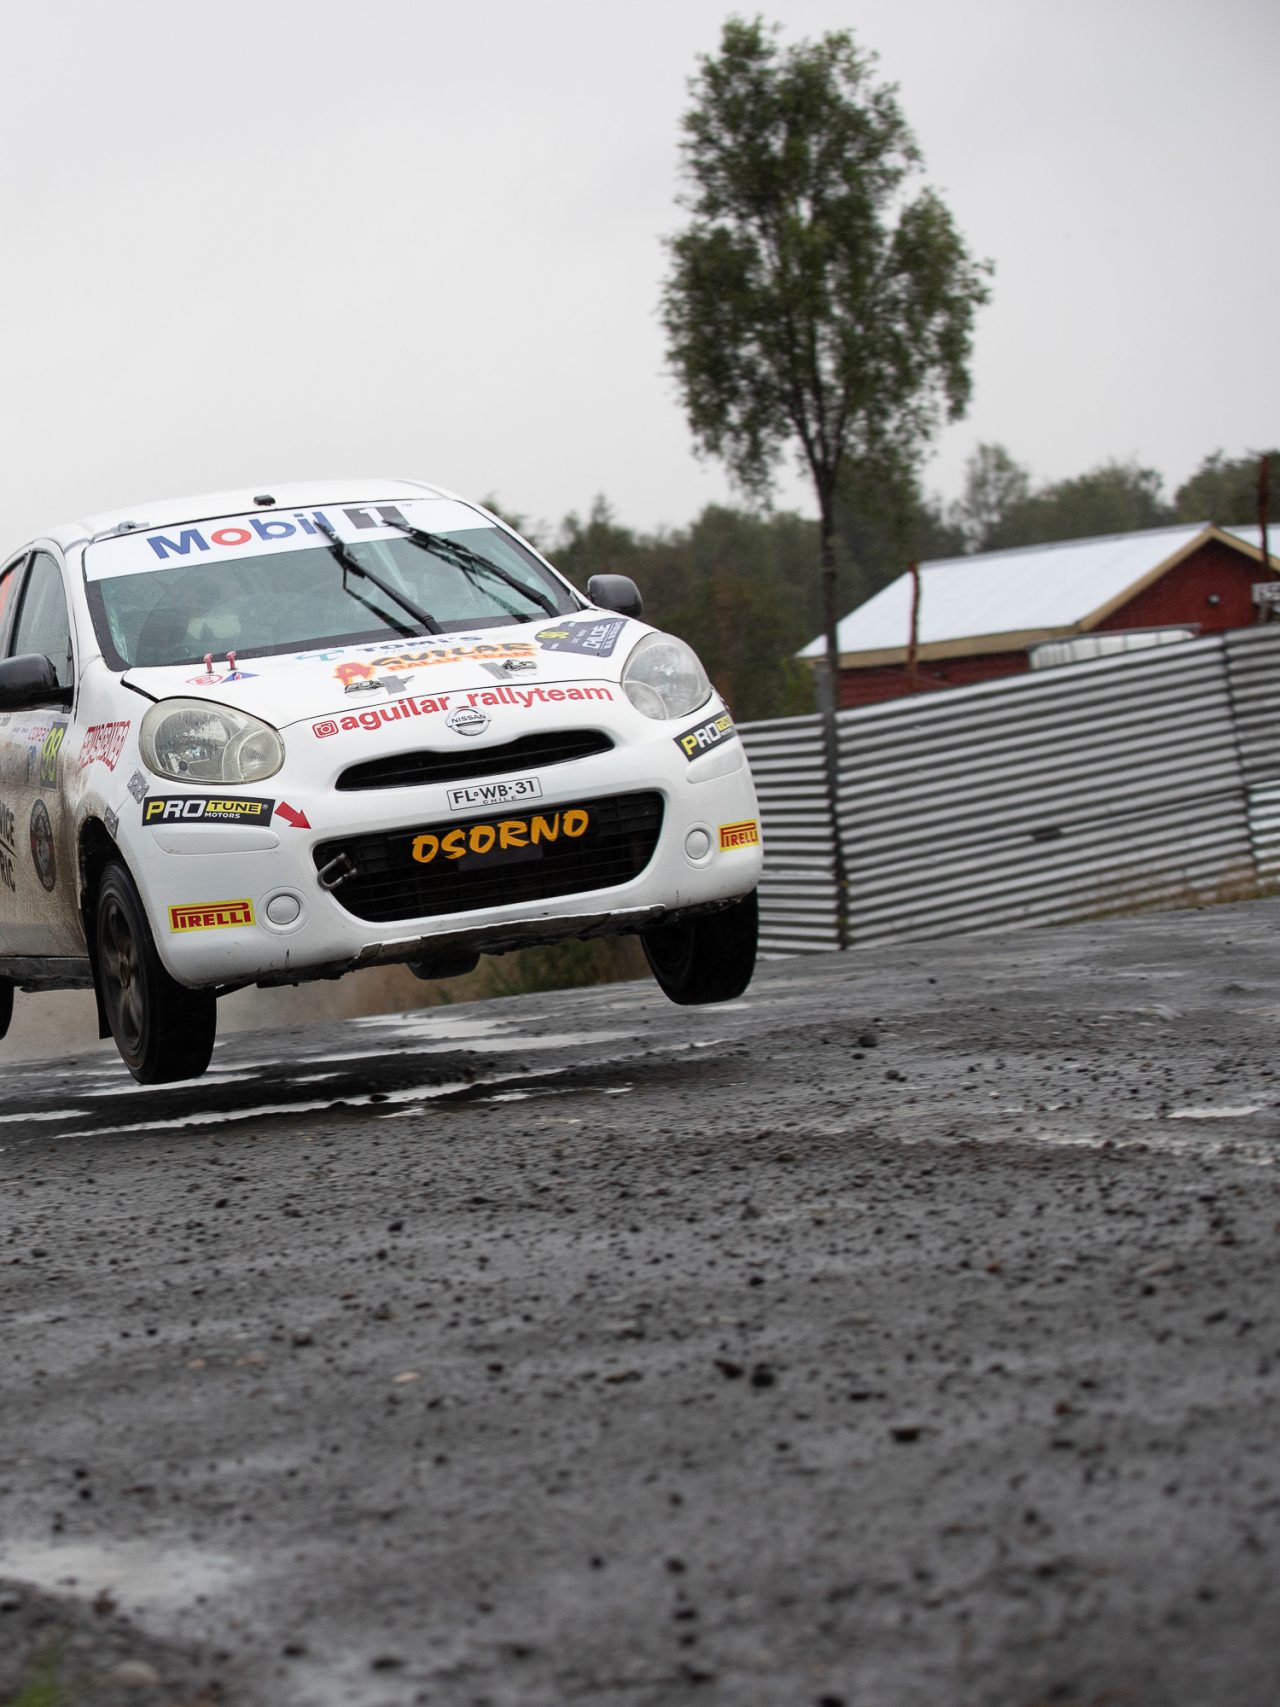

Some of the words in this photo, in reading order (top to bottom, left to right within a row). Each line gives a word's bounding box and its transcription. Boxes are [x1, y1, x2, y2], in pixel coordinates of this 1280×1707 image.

[147, 511, 335, 560] Mobil
[332, 642, 538, 688] AGUILAR
[451, 714, 487, 723] NISSAN
[681, 722, 722, 756] PRO
[41, 727, 64, 782] 98
[146, 800, 206, 820] PRO
[211, 802, 260, 812] TUNE
[483, 795, 518, 805] CHILE
[412, 809, 589, 863] OSORNO
[720, 822, 759, 848] PIRELLI
[171, 902, 251, 929] PIRELLI
